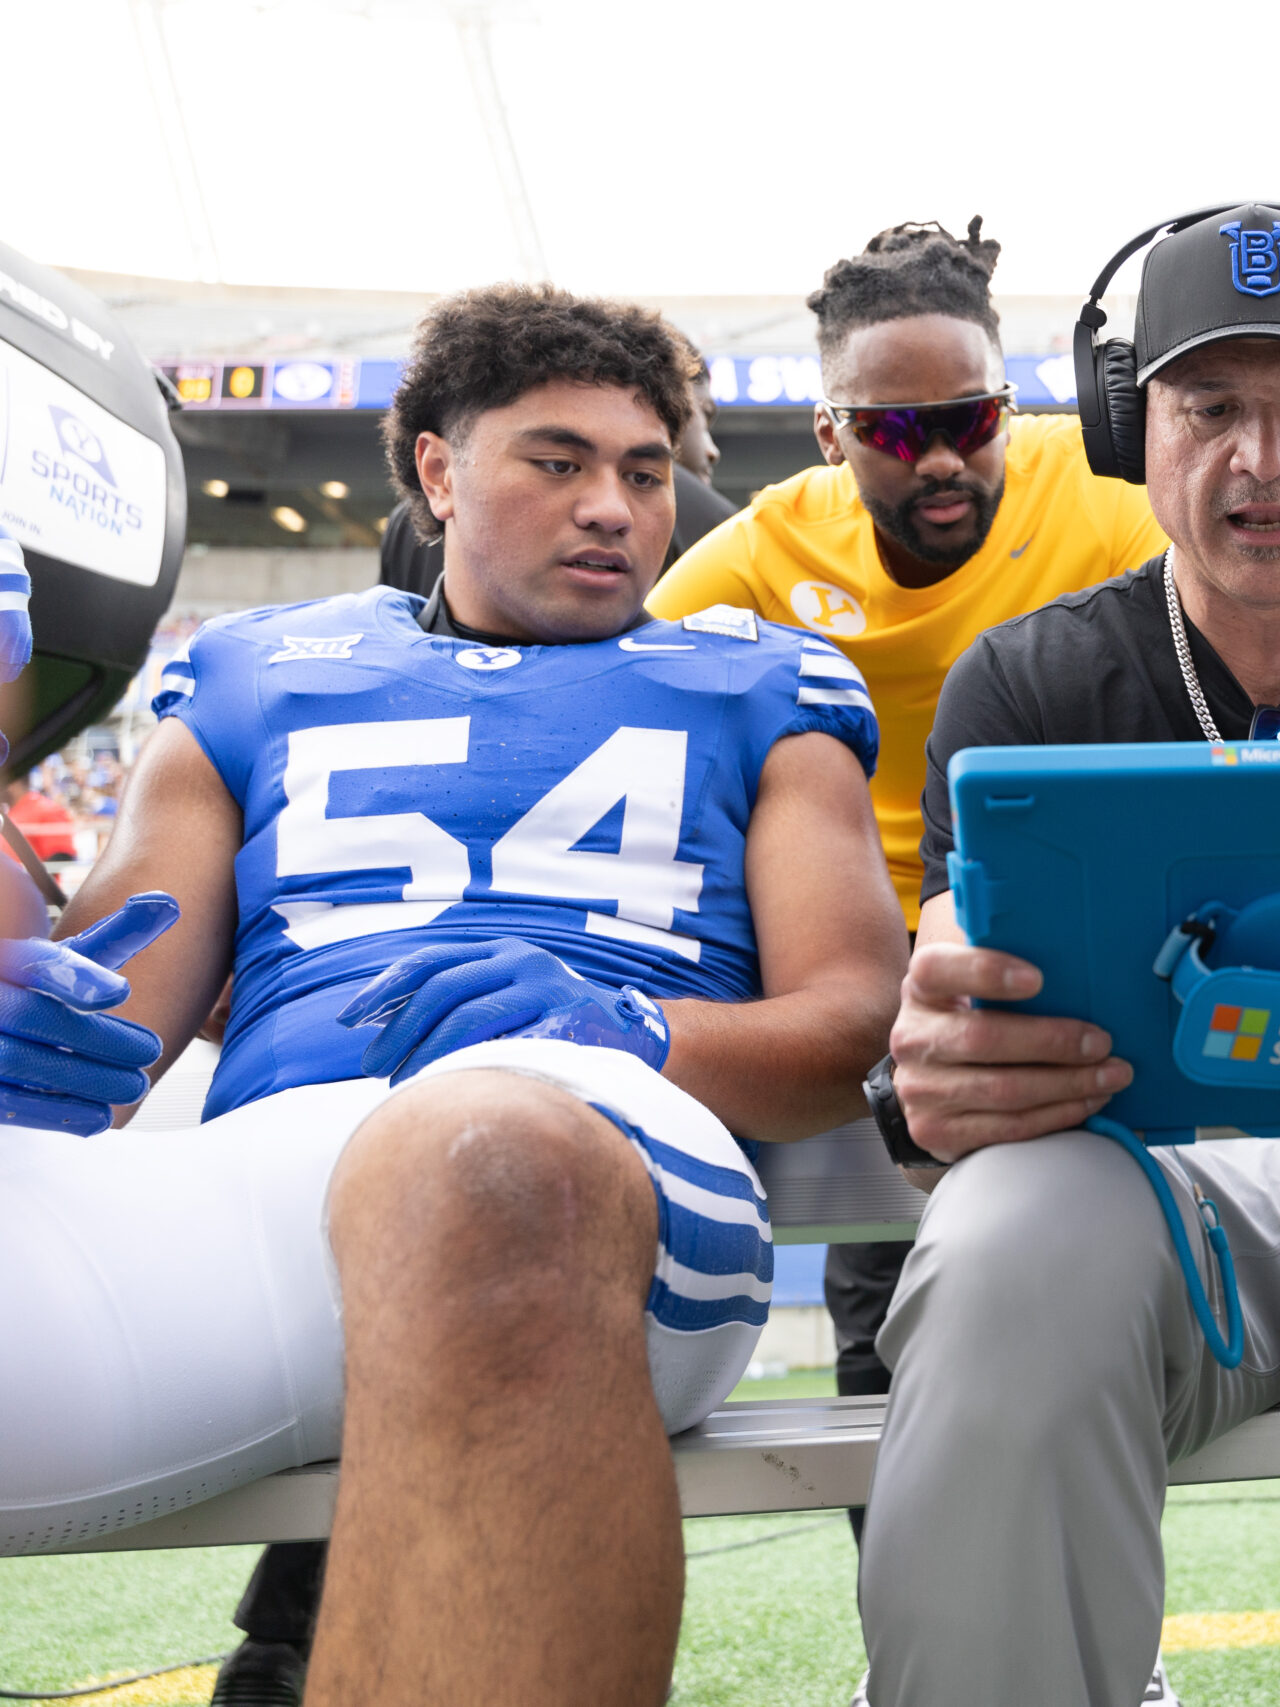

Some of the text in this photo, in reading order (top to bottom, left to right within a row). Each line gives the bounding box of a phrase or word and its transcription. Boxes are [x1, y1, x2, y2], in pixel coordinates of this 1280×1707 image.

[31, 450, 142, 529] SPORTS
[49, 485, 122, 536] NATION
[271, 714, 704, 964] 54
